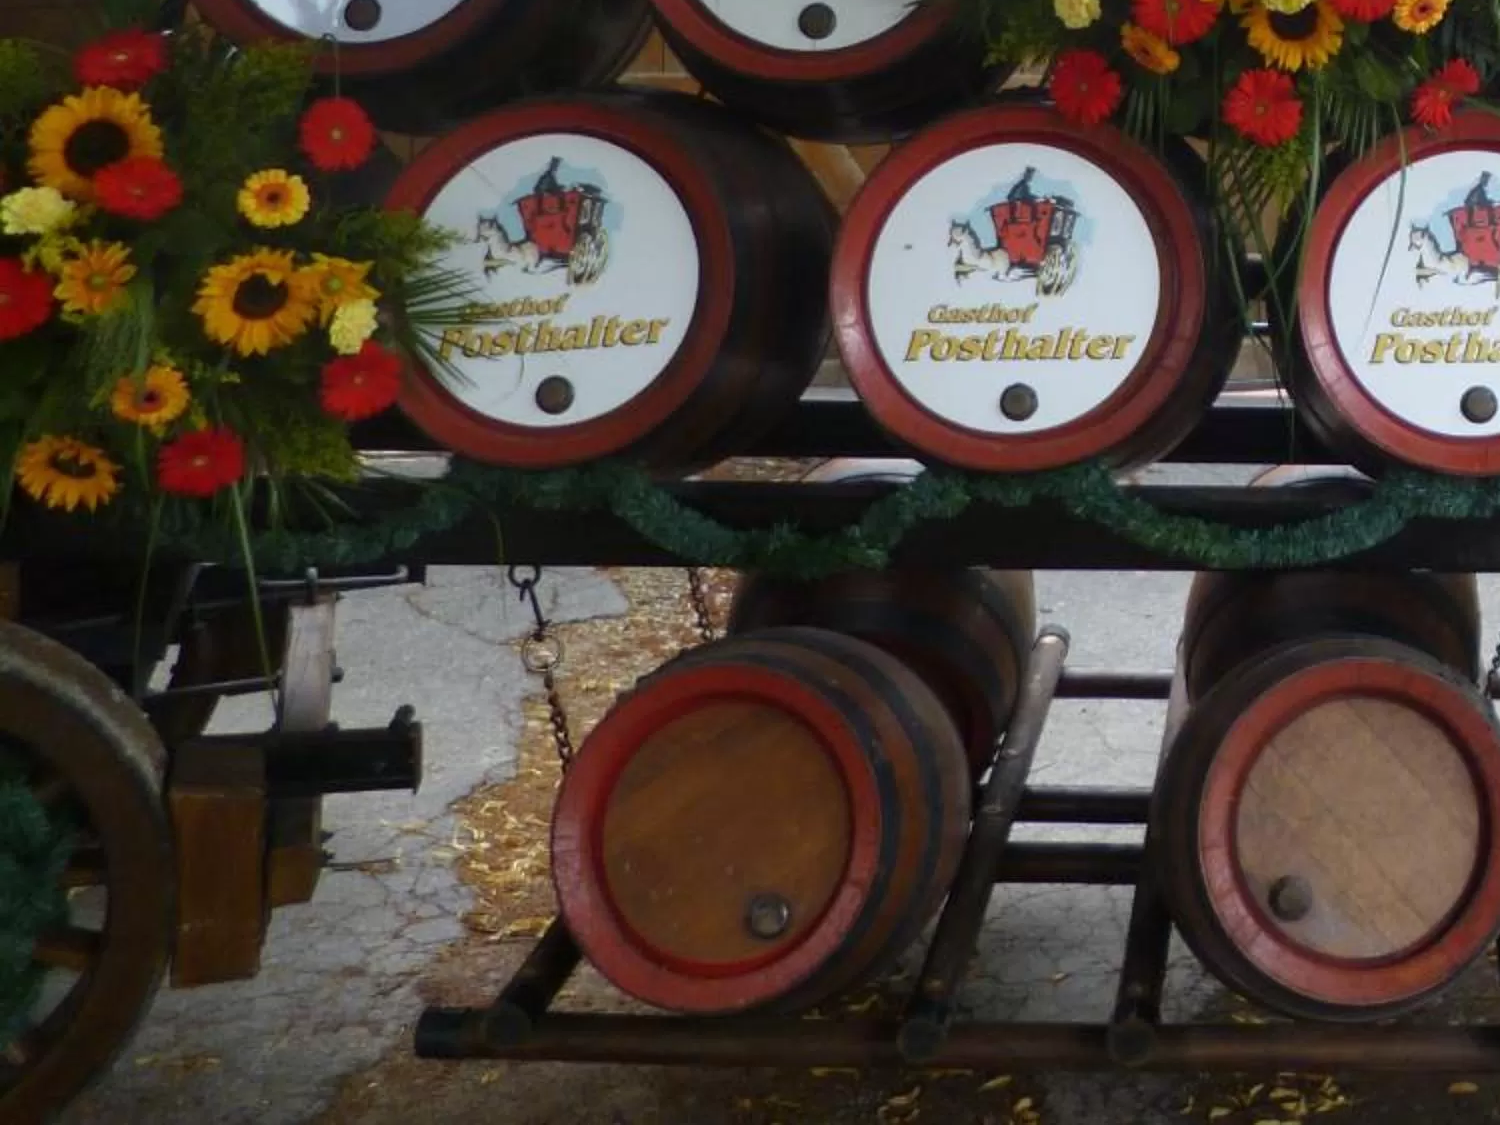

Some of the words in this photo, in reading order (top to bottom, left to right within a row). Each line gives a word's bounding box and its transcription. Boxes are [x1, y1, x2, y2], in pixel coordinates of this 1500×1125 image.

[927, 302, 1038, 324] Gasthof
[1390, 306, 1499, 328] Gasthof
[437, 315, 670, 361] Posthalter
[903, 326, 1136, 362] Posthalter
